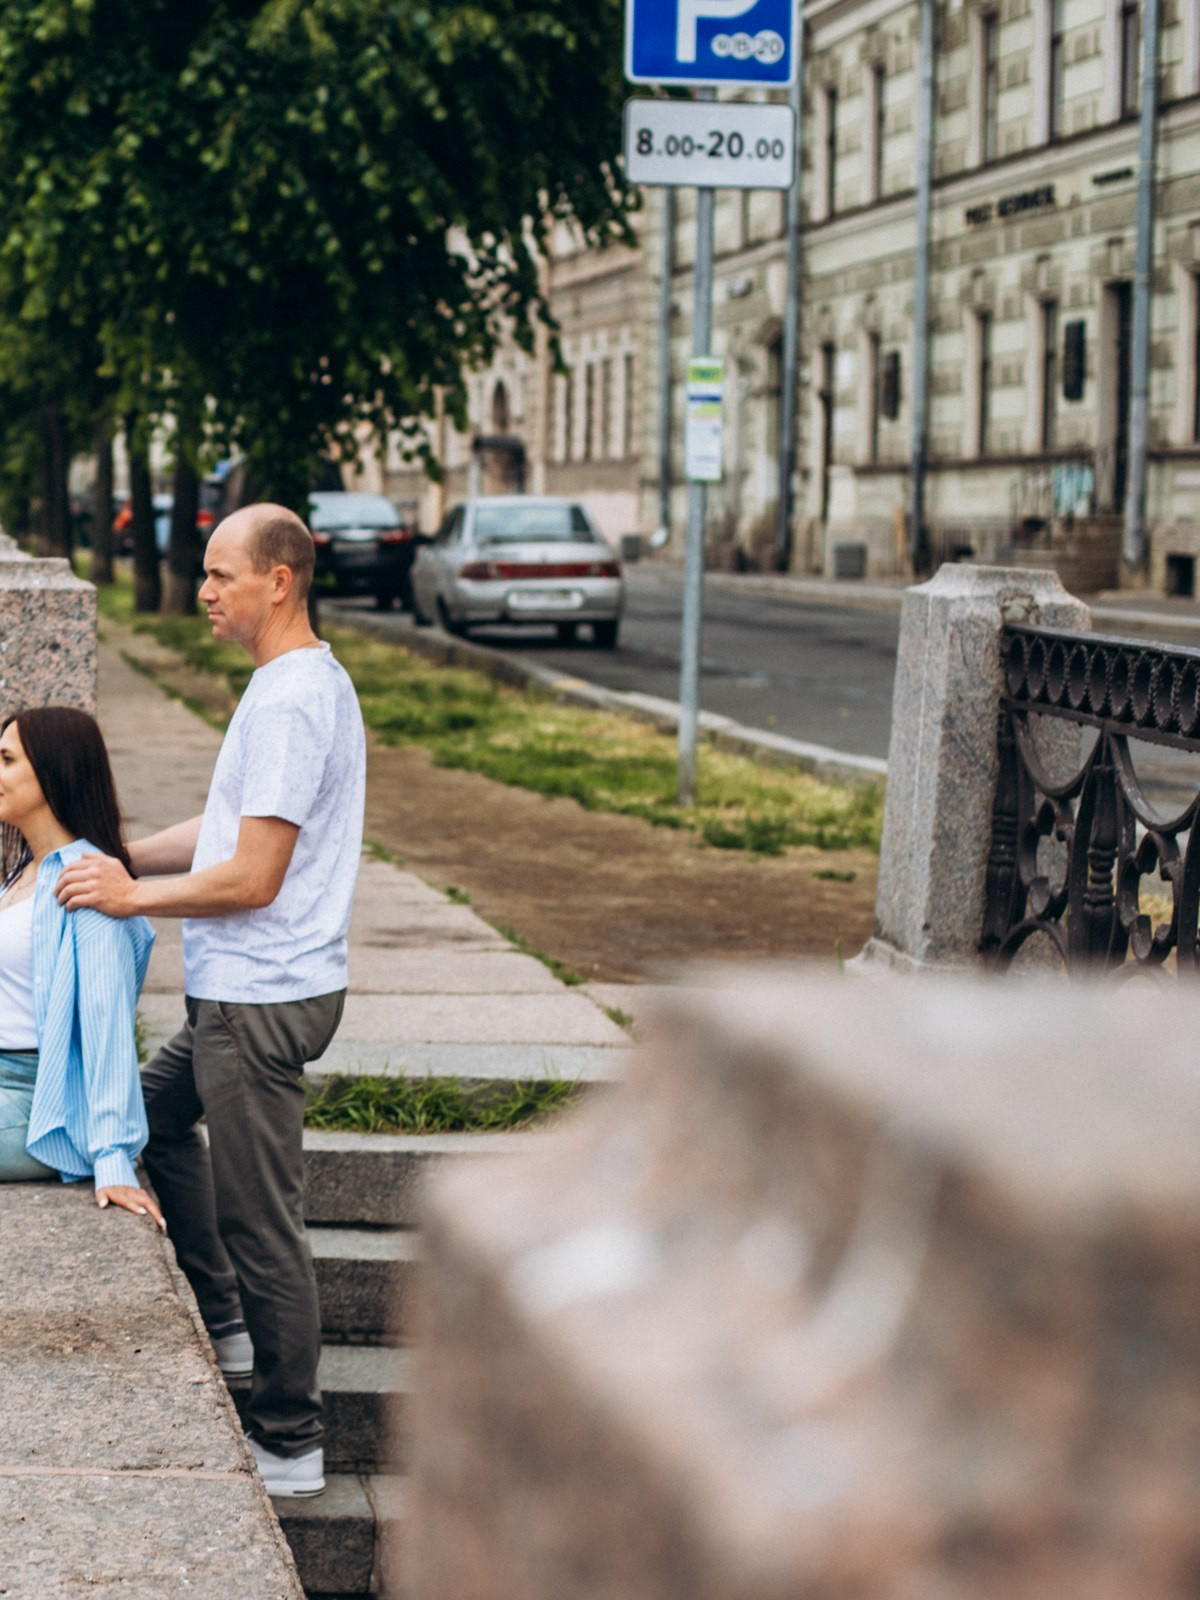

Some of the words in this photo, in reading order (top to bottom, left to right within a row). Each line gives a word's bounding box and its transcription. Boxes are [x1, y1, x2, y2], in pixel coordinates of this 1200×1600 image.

[676, 0, 760, 63] P
[756, 36, 781, 56] 20
[636, 128, 785, 160] 8.00-20.00
